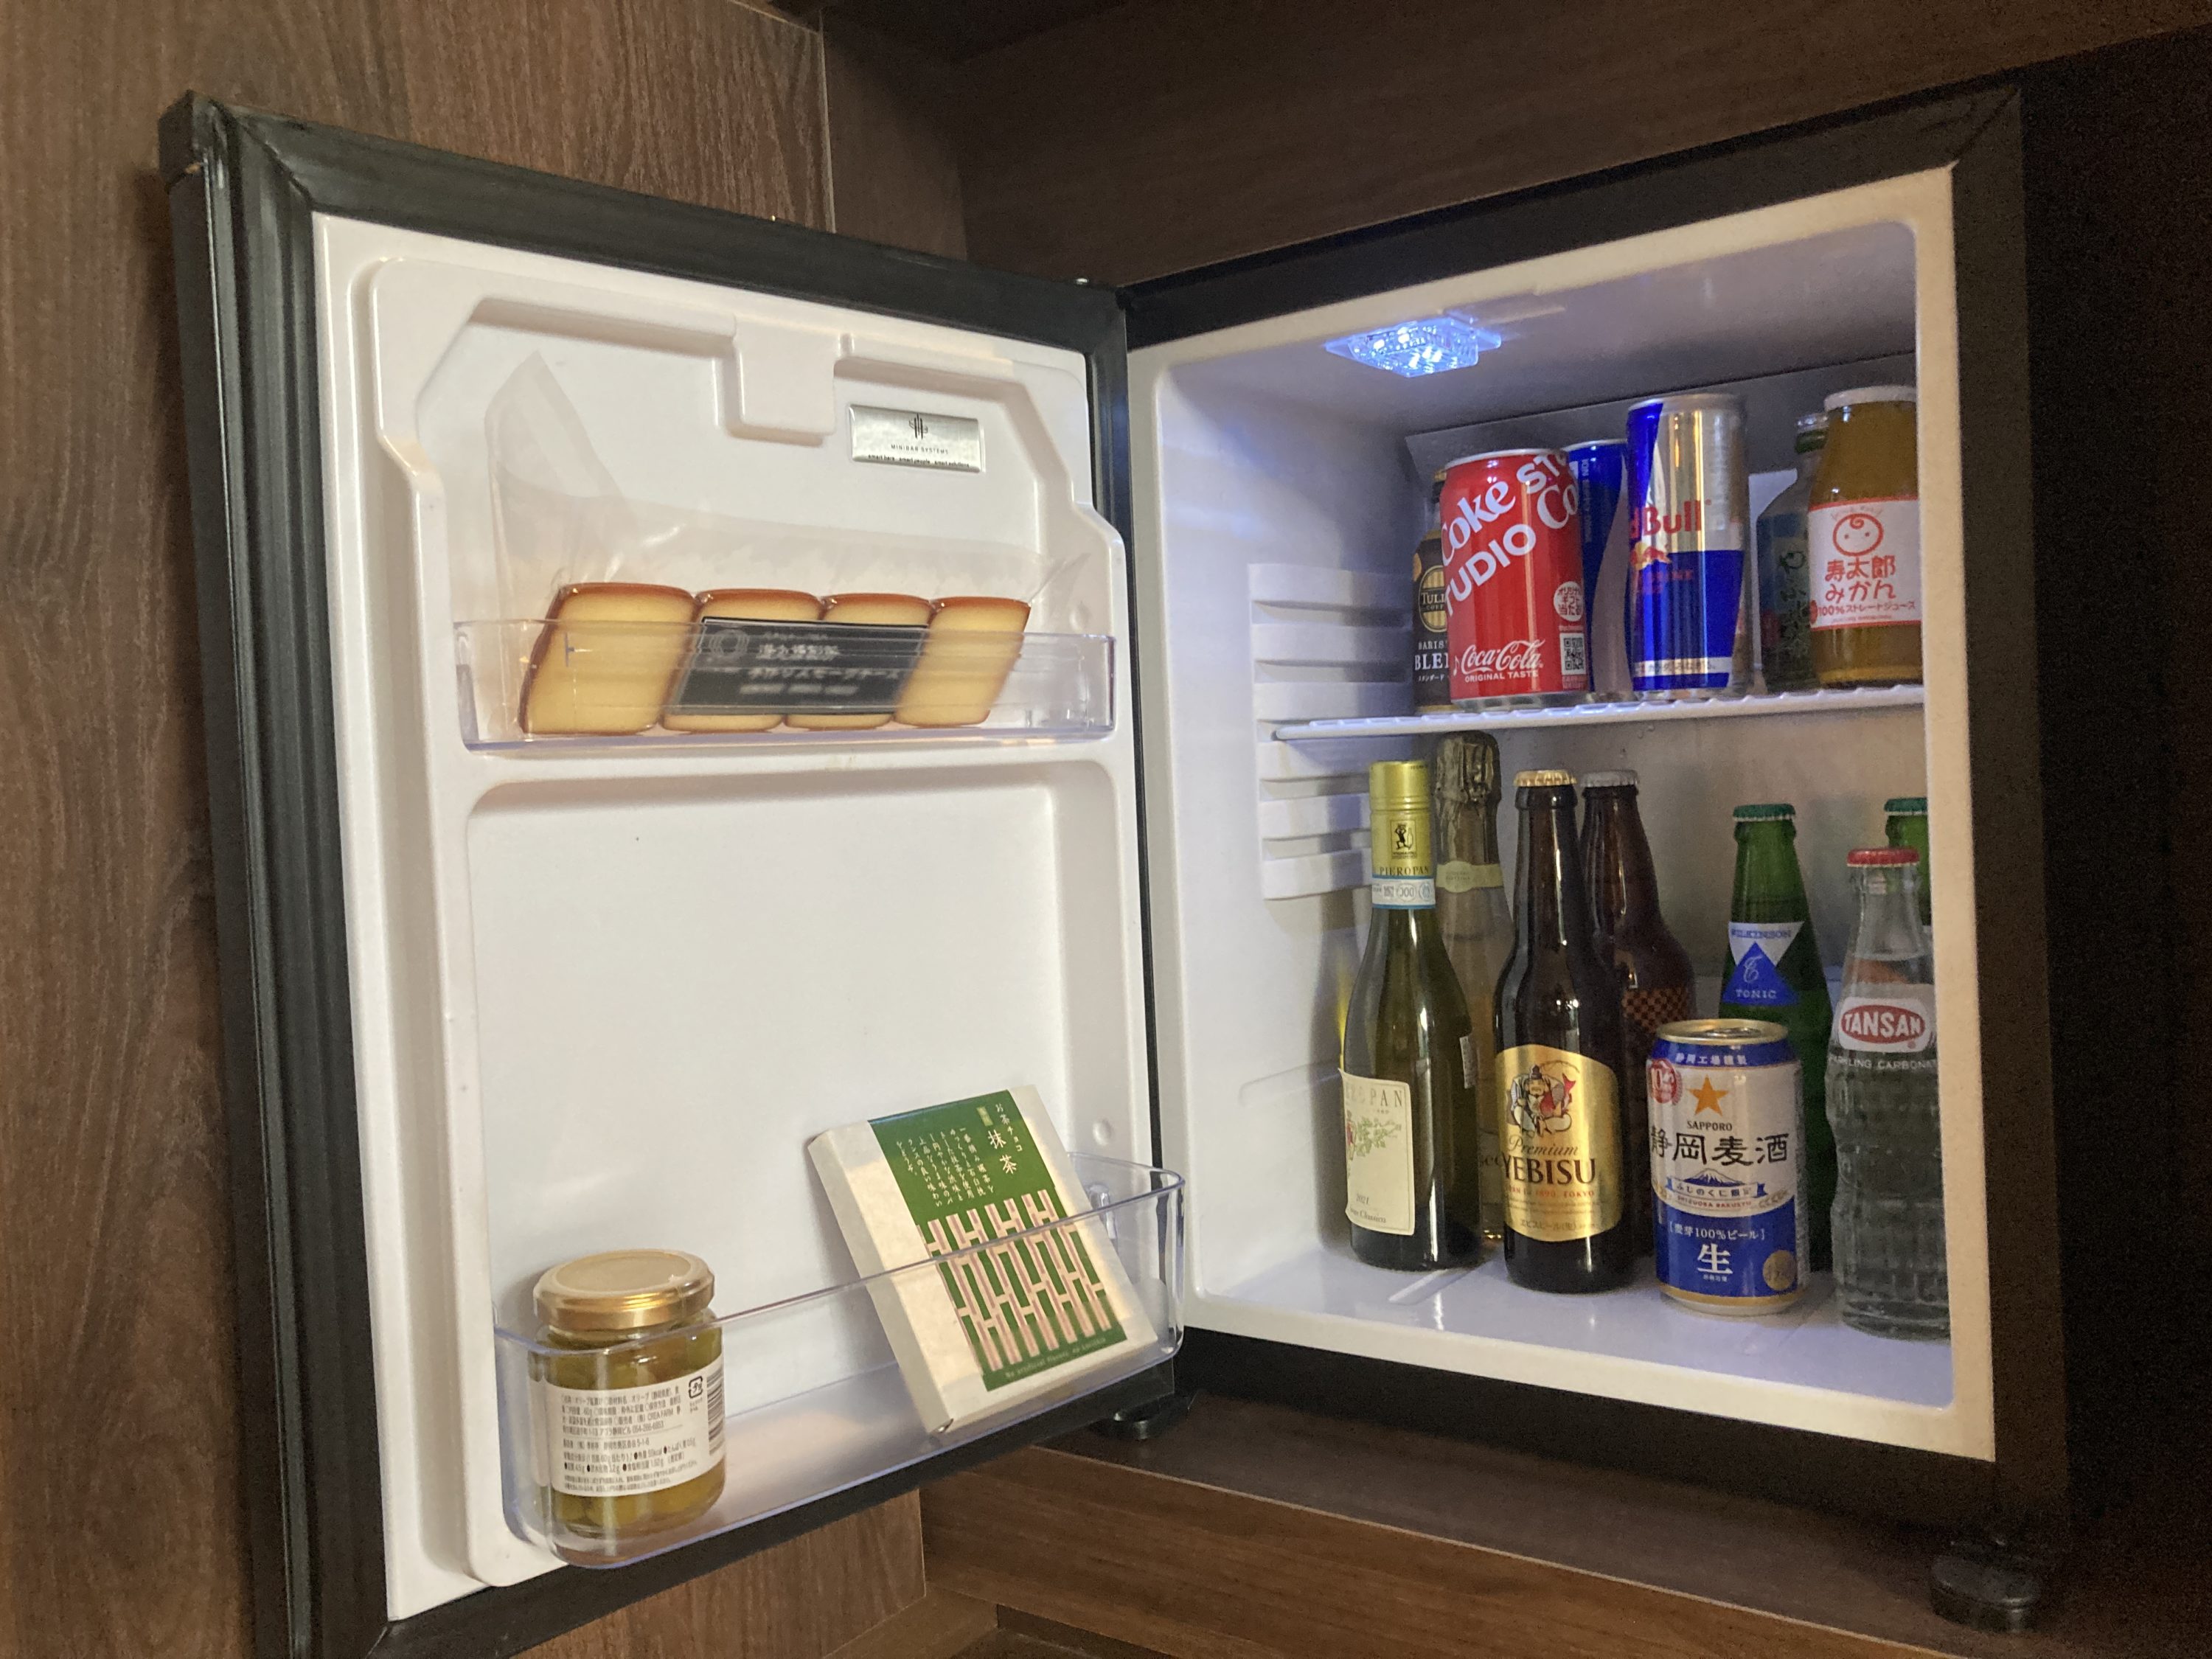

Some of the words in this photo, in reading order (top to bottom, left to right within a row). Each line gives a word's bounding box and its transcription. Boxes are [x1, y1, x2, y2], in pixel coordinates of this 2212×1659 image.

[1642, 500, 1703, 536] Bull
[1825, 554, 1896, 582] 寿太郎
[1825, 580, 1896, 604] みかん
[1418, 640, 1448, 650] BARIS
[1464, 673, 1505, 683] ORIGINAL
[1509, 669, 1540, 678] TASTE
[1735, 989, 1777, 999] TONIC
[1844, 1011, 1921, 1038] TANSAN
[1686, 1120, 1733, 1132] SAPPORO
[987, 1129, 1018, 1175] 抹茶
[1509, 1134, 1579, 1156] Premium
[1650, 1125, 1790, 1166] 静岡麦酒
[1502, 1152, 1596, 1185] YEBISU
[1697, 1242, 1733, 1275] 生
